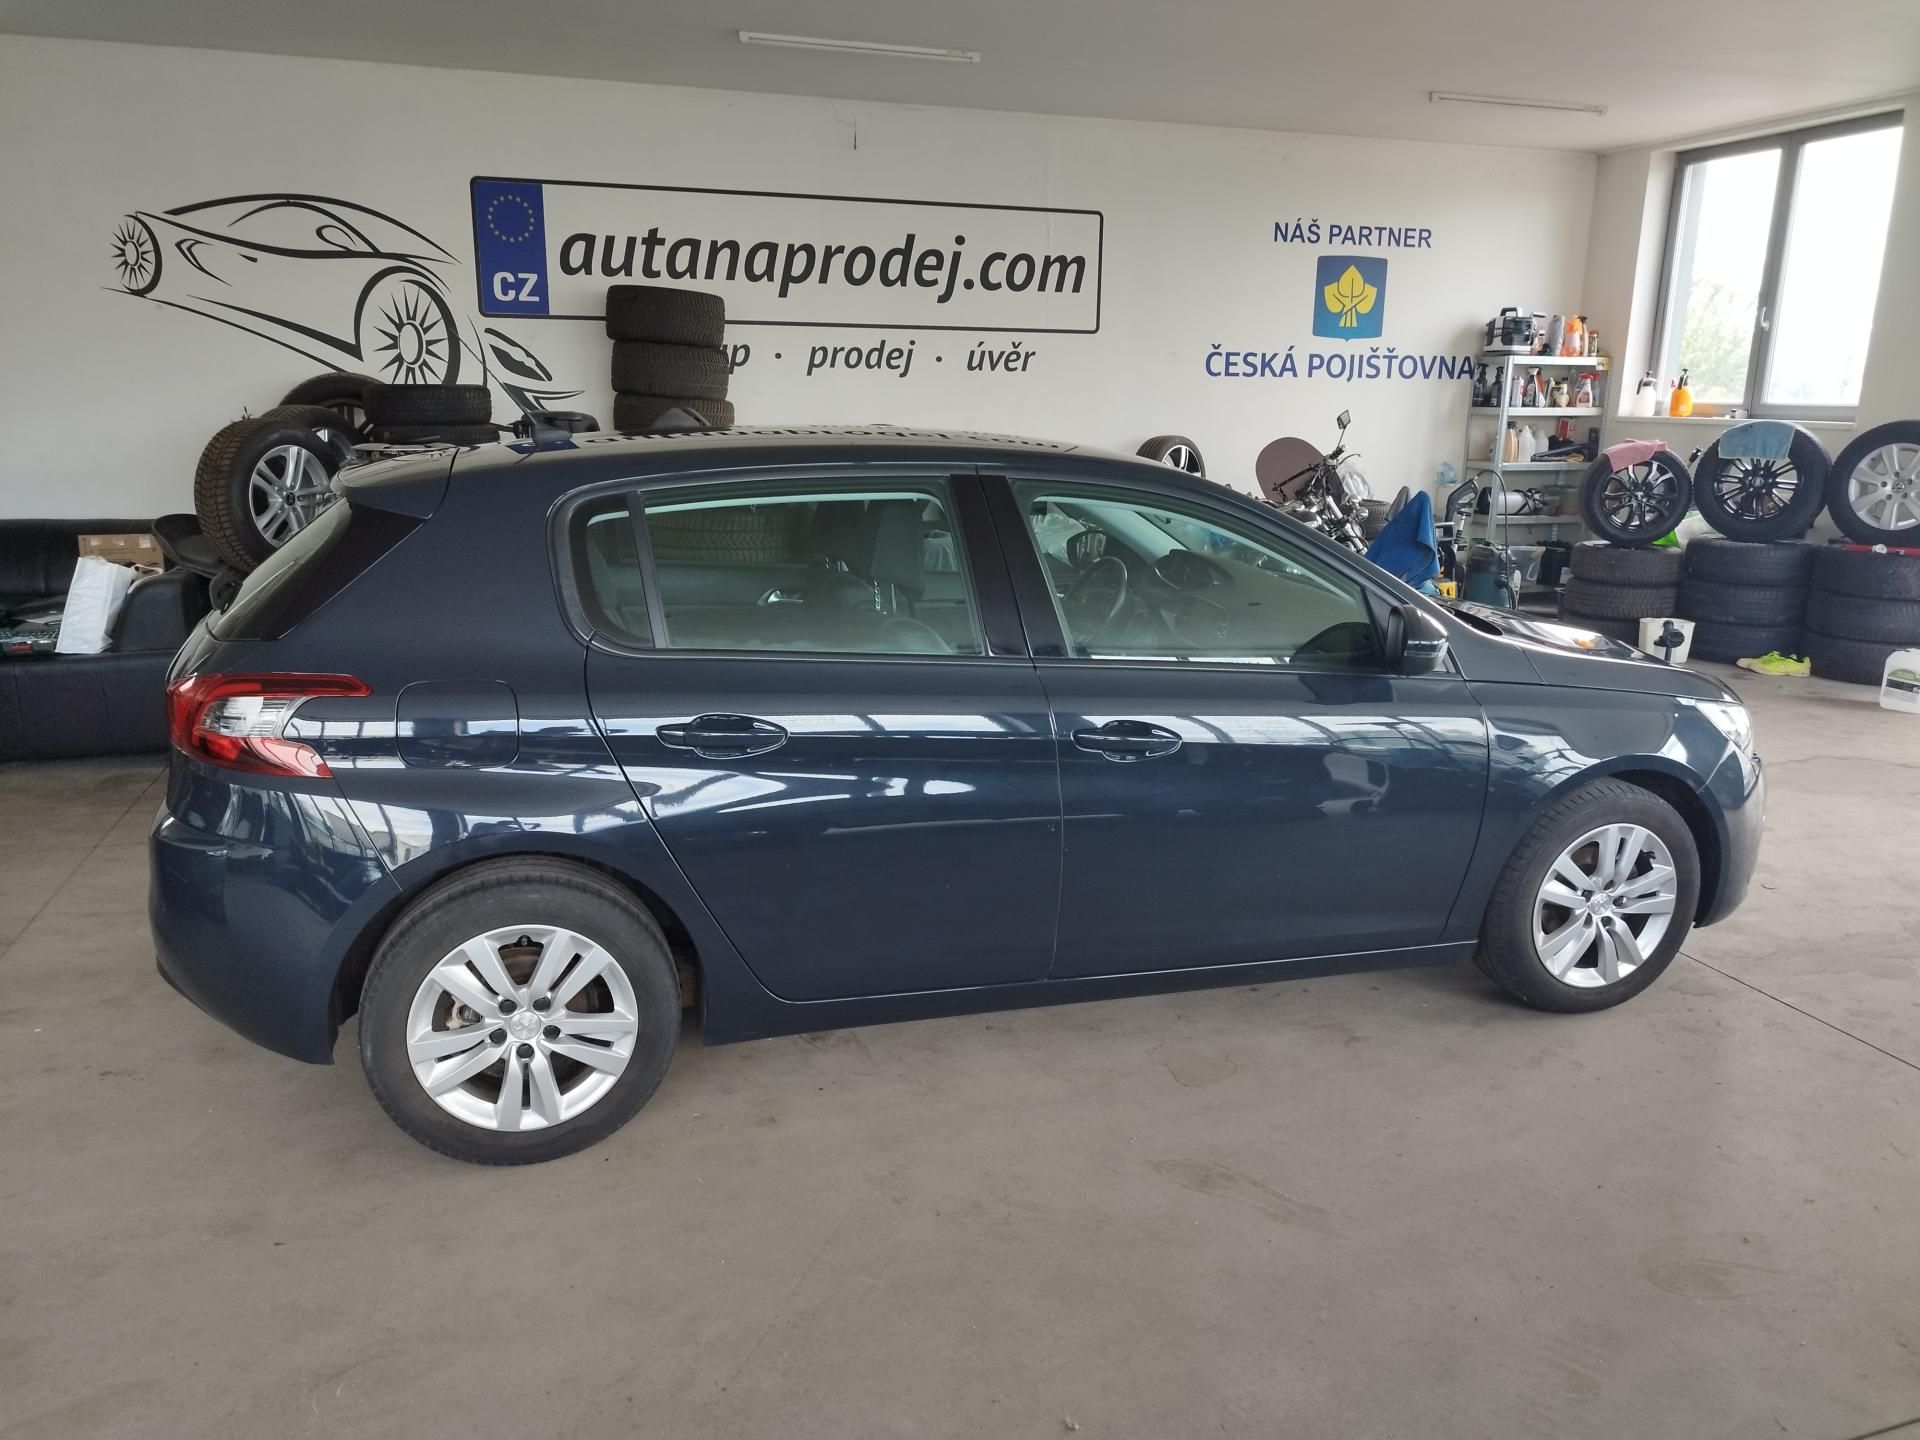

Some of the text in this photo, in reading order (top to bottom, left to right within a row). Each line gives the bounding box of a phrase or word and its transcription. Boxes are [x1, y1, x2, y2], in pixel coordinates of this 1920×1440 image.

[1273, 217, 1432, 249] NÁŠ PARTNER
[559, 226, 1086, 304] autanaprodej.com
[493, 271, 540, 302] CZ
[806, 339, 916, 377] prodej
[966, 340, 1037, 372] úvěr
[1205, 343, 1475, 383] ČESKÁ POJIŠŤOVNA
